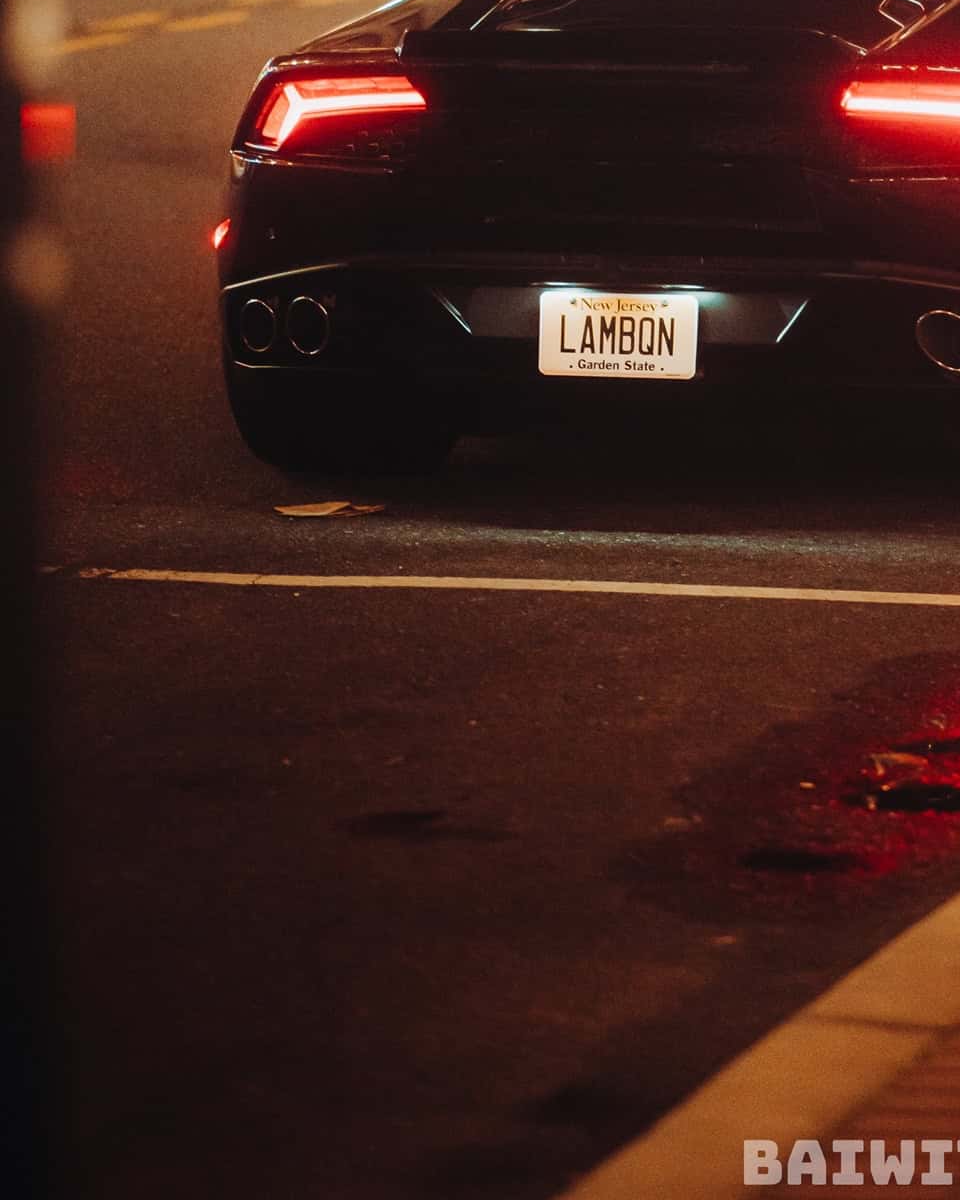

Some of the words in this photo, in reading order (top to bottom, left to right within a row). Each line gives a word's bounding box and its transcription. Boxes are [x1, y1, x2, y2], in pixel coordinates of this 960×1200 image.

[581, 298, 612, 310] New
[614, 299, 658, 313] Jersey
[560, 314, 675, 356] LAMBQN
[578, 359, 620, 371] Garden
[624, 360, 656, 372] State
